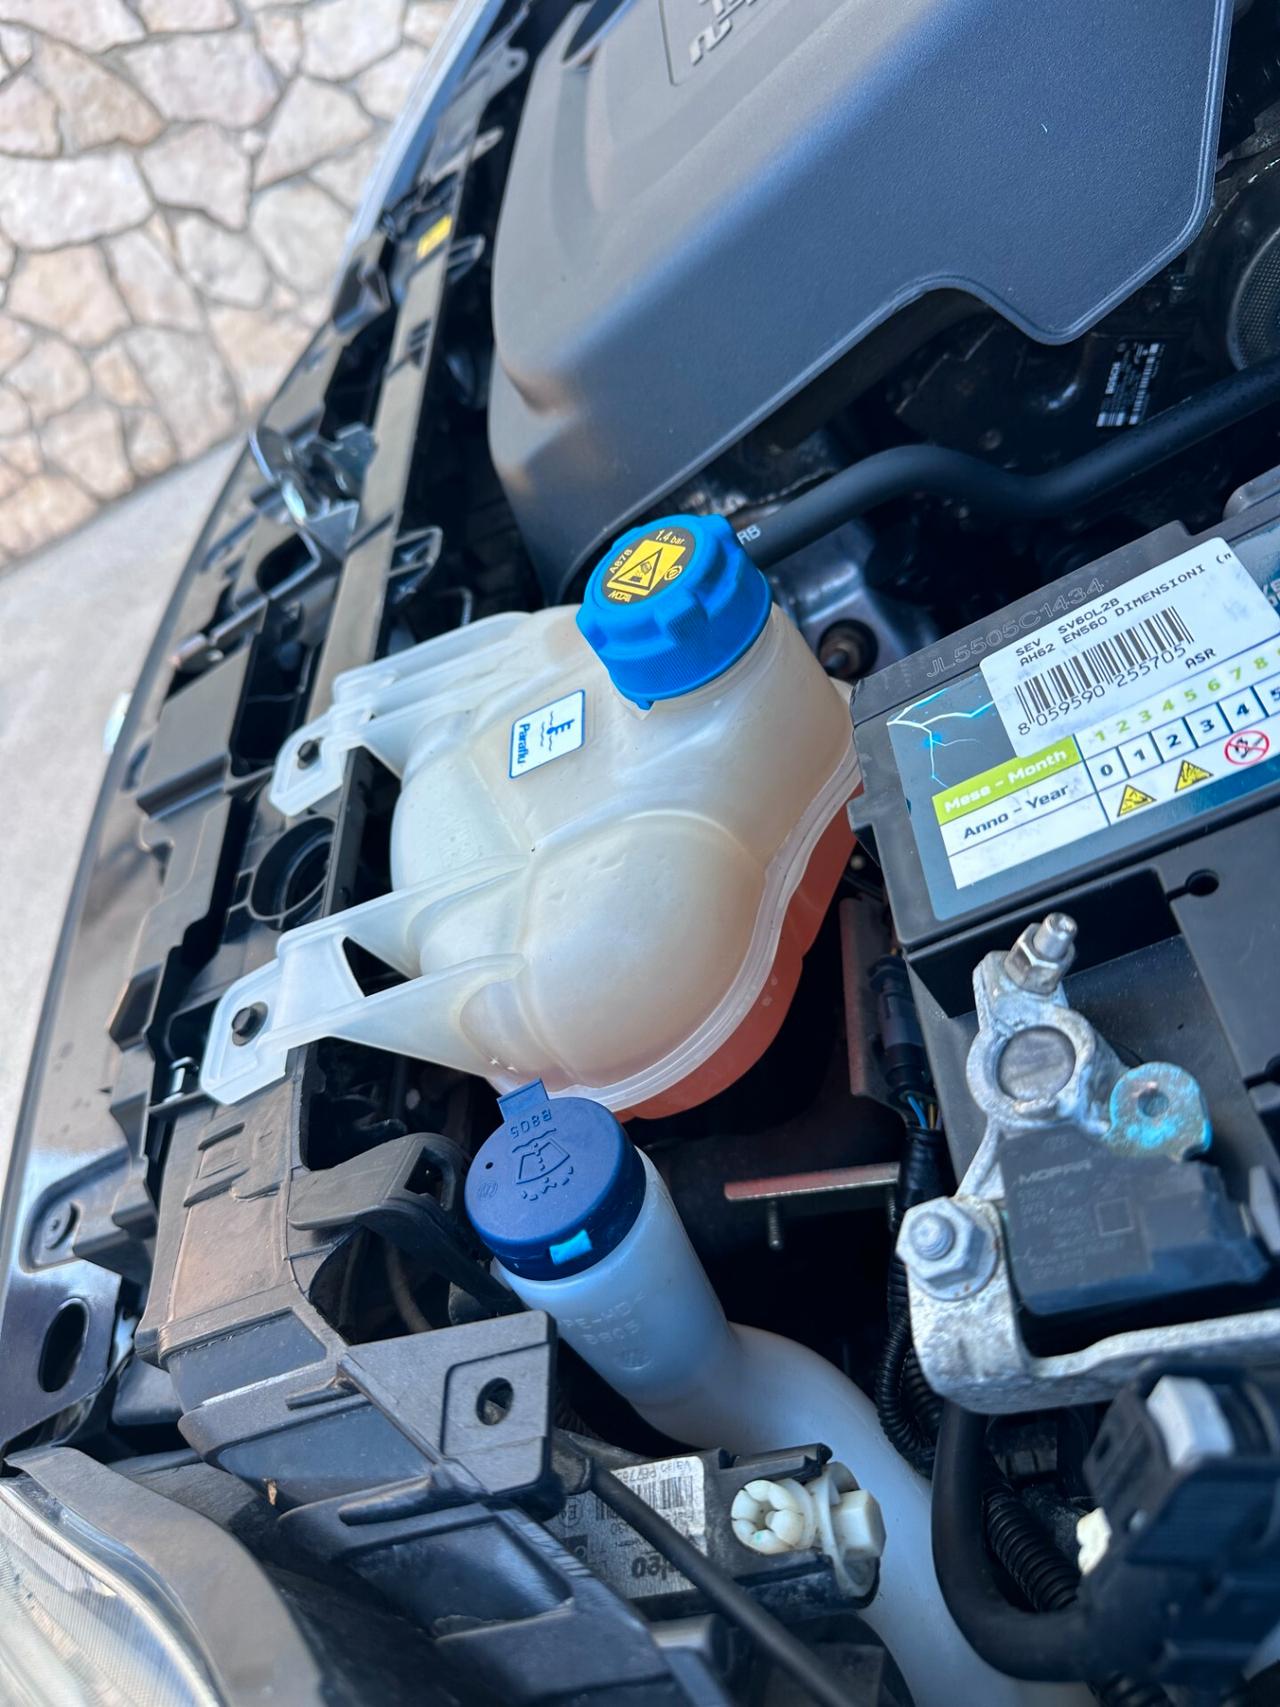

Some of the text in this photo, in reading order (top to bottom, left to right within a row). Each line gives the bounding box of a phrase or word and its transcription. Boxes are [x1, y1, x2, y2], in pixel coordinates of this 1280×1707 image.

[1015, 597, 1120, 657] SEV SV60L2B
[1019, 643, 1056, 667] AH62
[1062, 616, 1108, 644] EN560
[1114, 563, 1206, 617] DIMENSIONI
[1184, 648, 1216, 669] ASR
[944, 785, 992, 813] Mese
[1007, 750, 1068, 784] Month
[1095, 730, 1106, 742] 1
[1116, 719, 1131, 733] 2
[1138, 709, 1152, 724] 3
[1162, 699, 1175, 713] 4
[1184, 689, 1198, 703] 5
[1207, 678, 1222, 692] 6
[1229, 666, 1242, 681] 7
[1253, 657, 1269, 670] 8
[1018, 643, 1187, 735] 8 059590 255705
[964, 813, 1009, 840] Anno
[1025, 784, 1070, 810] Year
[1100, 764, 1114, 777] 0
[1133, 749, 1146, 762] 1
[1166, 734, 1182, 748] 2
[1200, 718, 1215, 734] 3
[1236, 703, 1250, 717] 4
